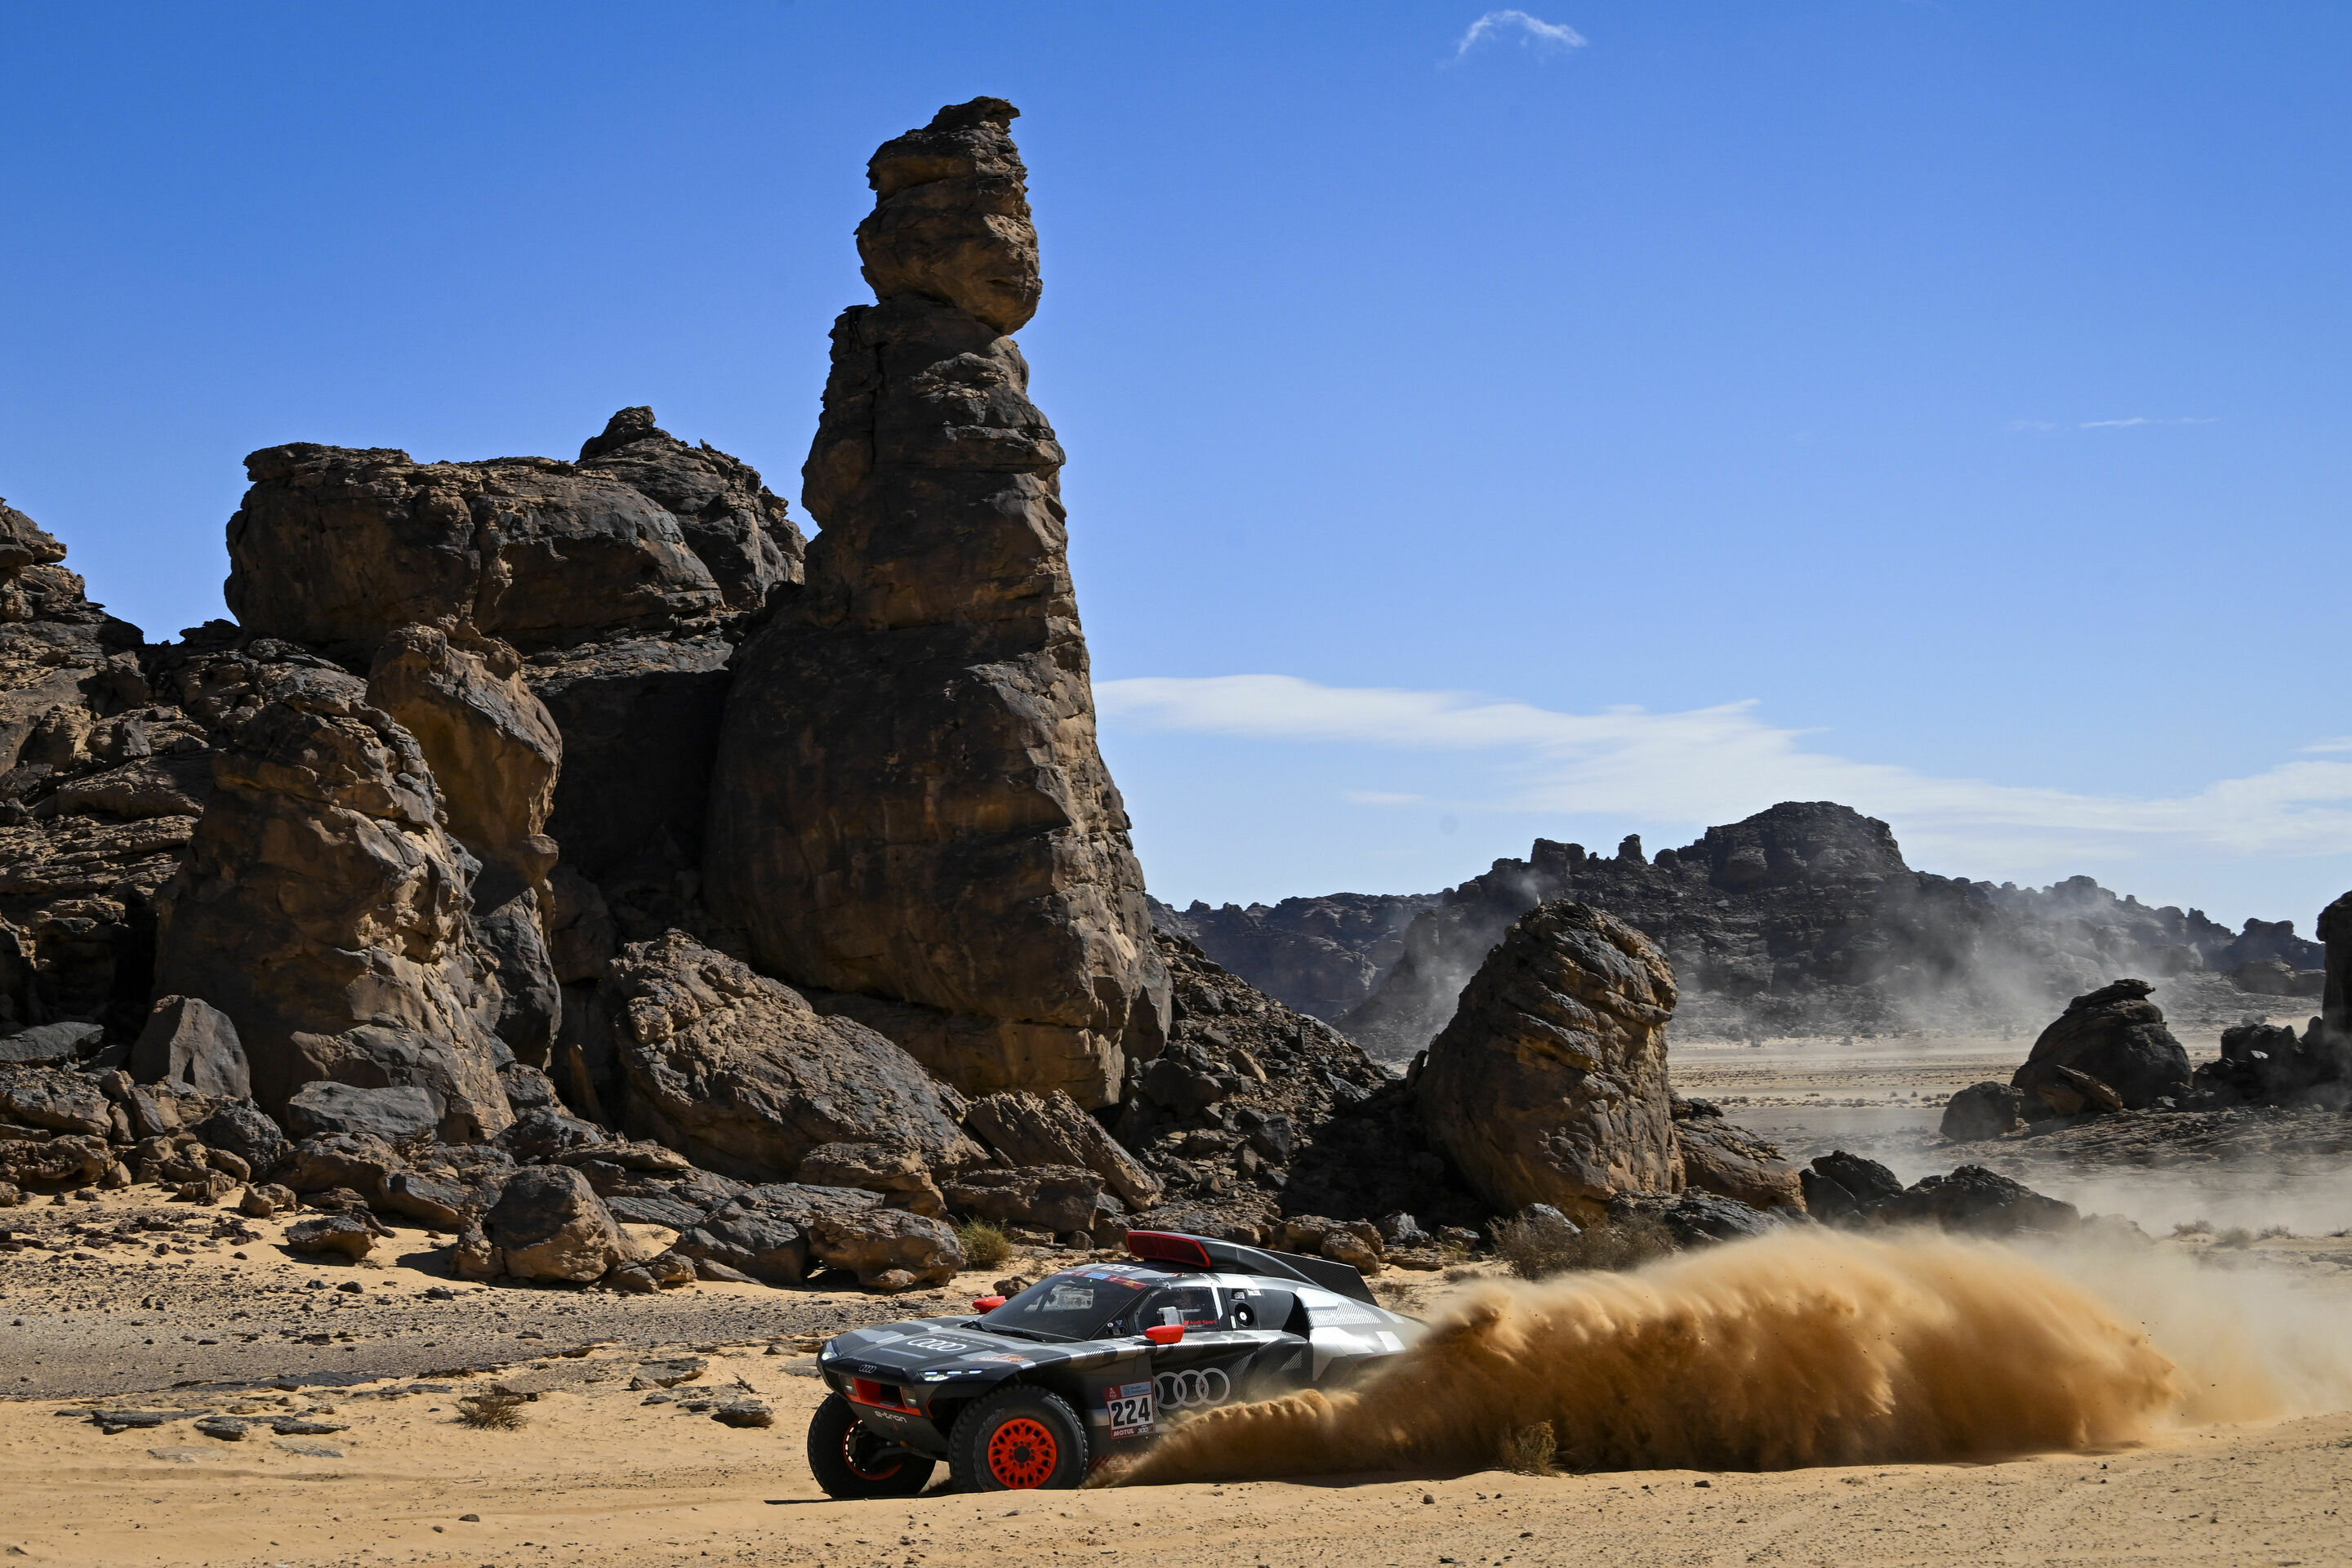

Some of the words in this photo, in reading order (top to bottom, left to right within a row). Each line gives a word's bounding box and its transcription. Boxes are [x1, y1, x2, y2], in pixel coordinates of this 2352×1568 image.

[875, 1410, 907, 1423] e-tron
[1111, 1397, 1150, 1427] 224
[1113, 1428, 1134, 1437] MOTUL
